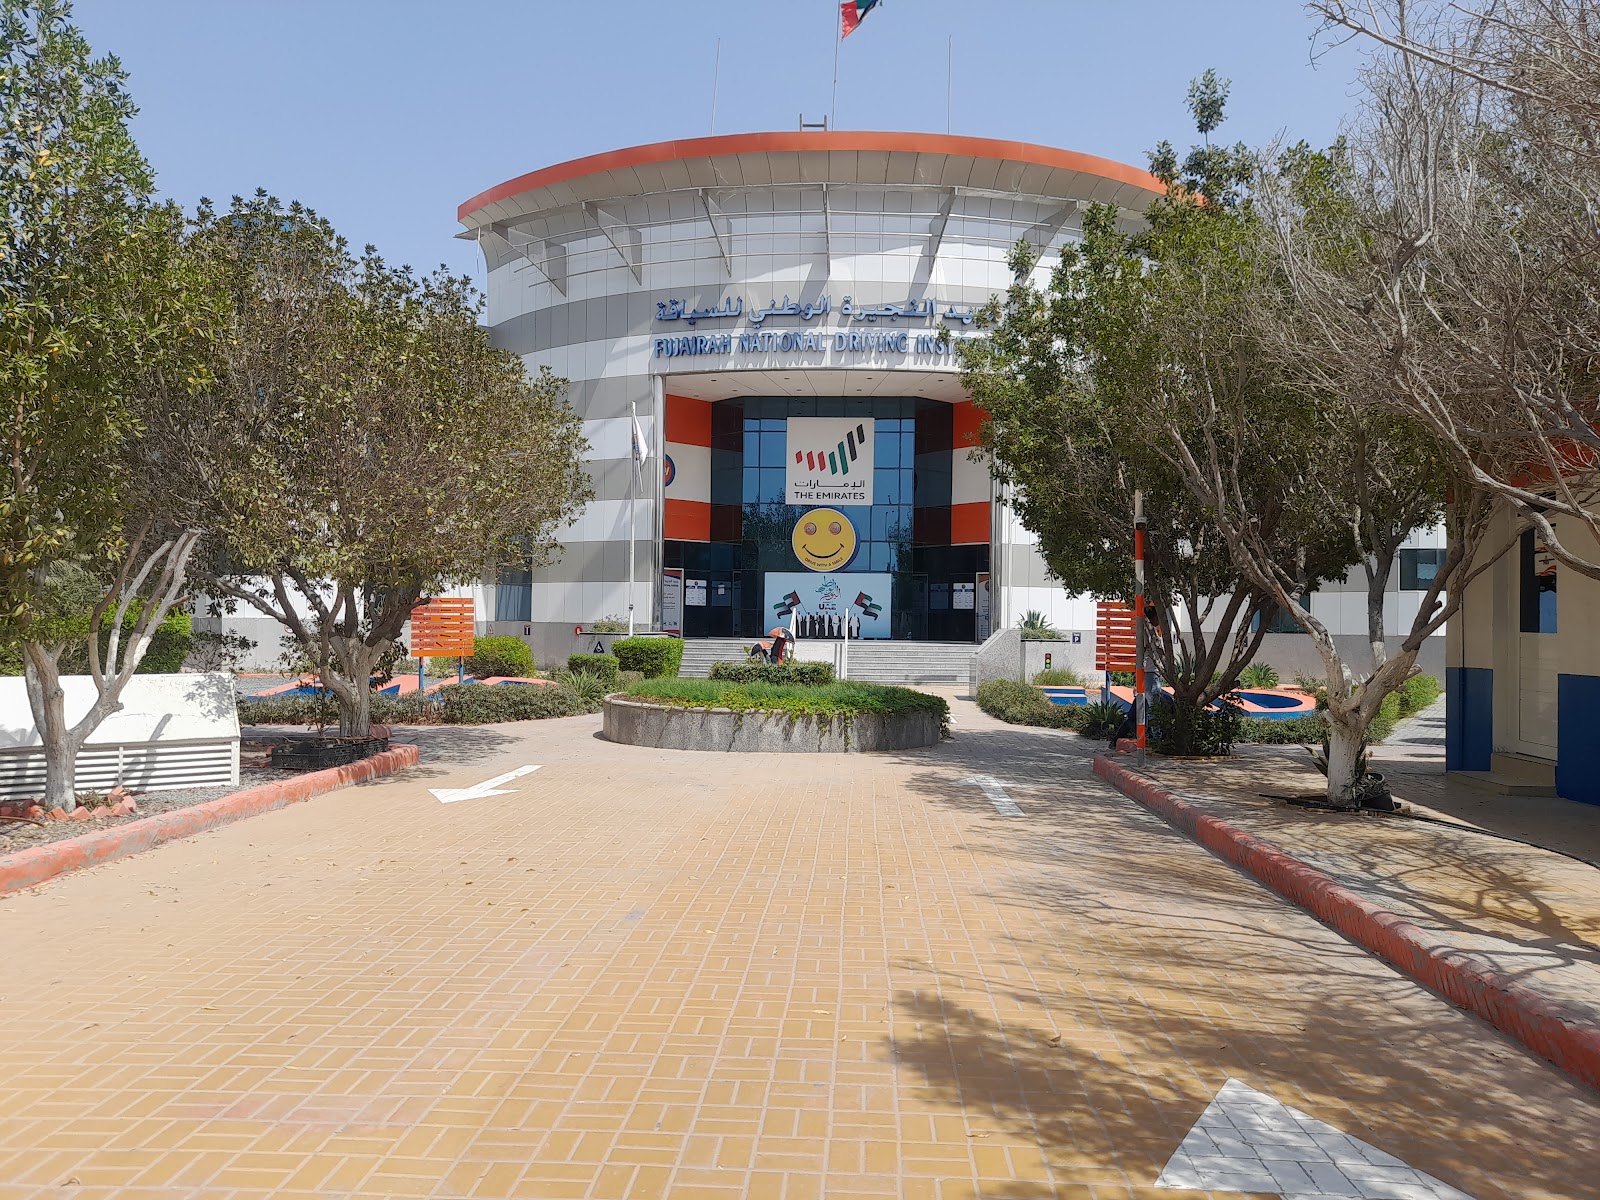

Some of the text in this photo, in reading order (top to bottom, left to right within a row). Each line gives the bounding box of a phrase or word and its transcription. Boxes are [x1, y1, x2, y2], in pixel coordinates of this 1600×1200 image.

[655, 295, 743, 325] للسياقة
[749, 294, 831, 329] الوطني
[841, 295, 937, 322] الفجيرة
[654, 334, 732, 358] FUJAIRAH
[739, 332, 827, 354] NATIONAL
[835, 331, 910, 354] DRIVING
[794, 479, 865, 490] الإمارات
[794, 491, 865, 500] THE EMIRATES
[804, 556, 816, 566] DRIVE
[832, 557, 844, 566] SMILE
